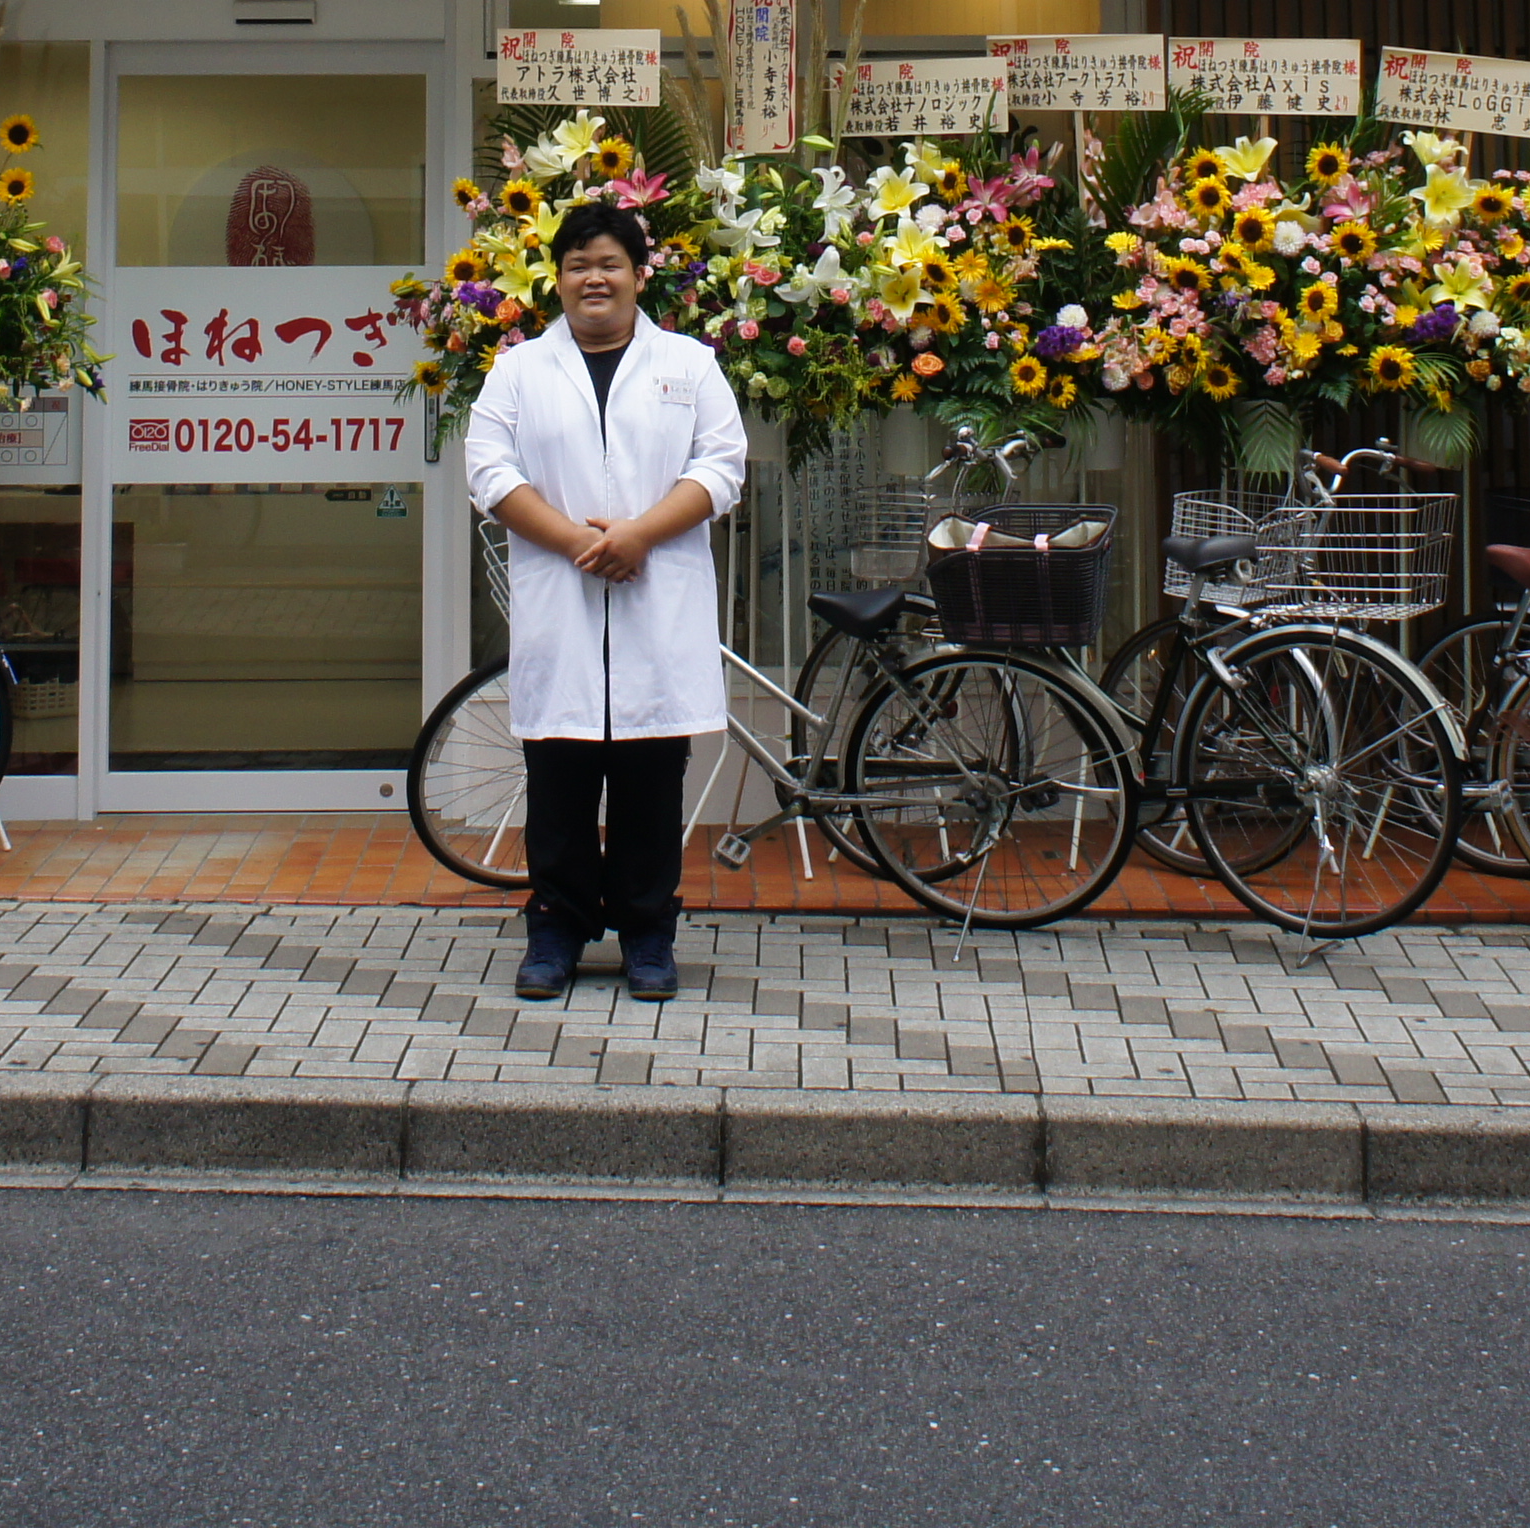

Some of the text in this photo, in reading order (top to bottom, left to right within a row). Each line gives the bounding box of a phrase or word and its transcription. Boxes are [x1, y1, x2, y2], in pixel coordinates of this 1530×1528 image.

[755, 7, 770, 42] 開院
[500, 35, 523, 60] 祝
[1172, 45, 1198, 70] 祝
[1383, 54, 1409, 80] 祝
[132, 307, 405, 366] ほねつぎ
[129, 443, 169, 452] FreeDial
[174, 418, 405, 452] 0120-54-1717
